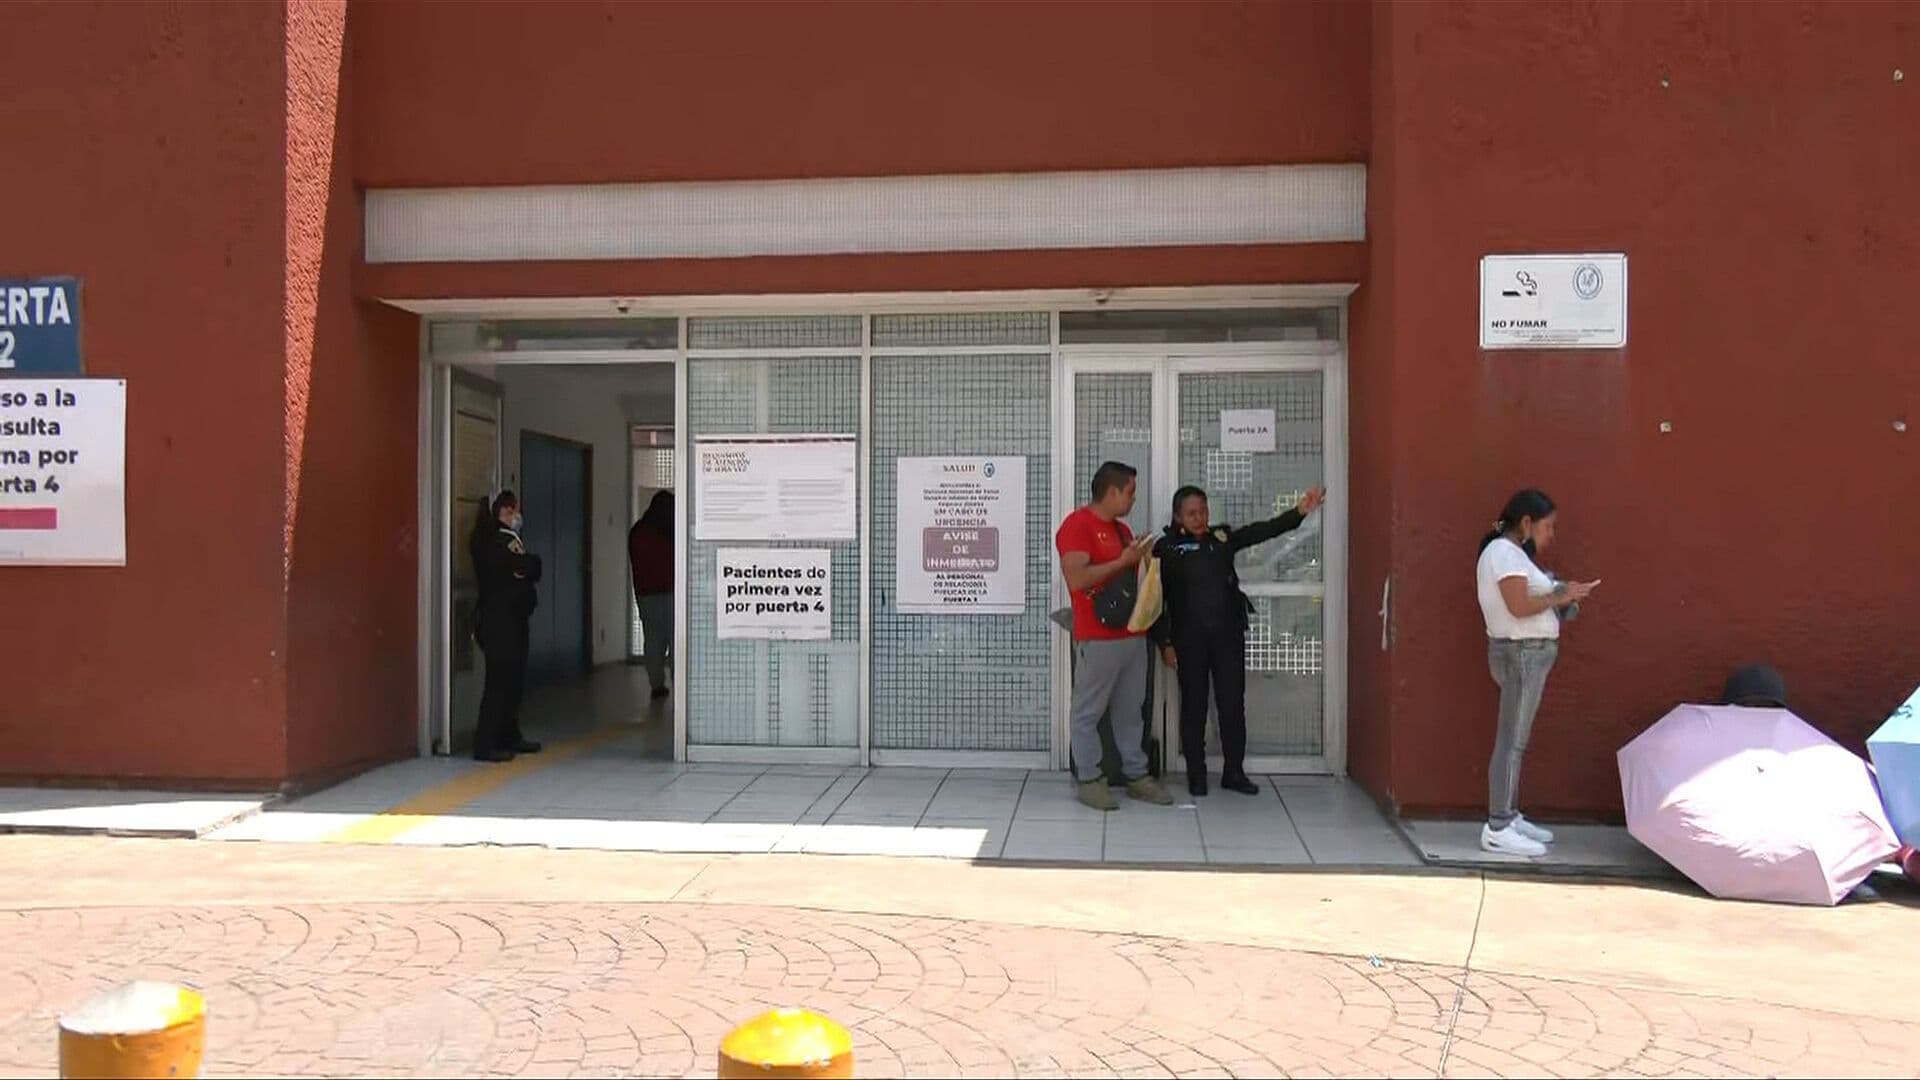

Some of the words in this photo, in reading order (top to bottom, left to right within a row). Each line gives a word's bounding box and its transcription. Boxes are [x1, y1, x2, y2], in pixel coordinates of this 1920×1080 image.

[1491, 320, 1507, 328] NO
[1509, 320, 1548, 328] FUMAR
[0, 331, 16, 368] 2
[34, 392, 48, 407] a
[55, 388, 76, 407] la
[0, 417, 61, 436] sulta
[38, 449, 79, 469] por
[943, 464, 976, 472] SALUD
[44, 475, 60, 493] 4
[943, 531, 979, 541] AVISE
[952, 545, 969, 554] DE
[926, 557, 996, 569] INMEDIATO
[723, 564, 802, 578] Pacientes
[806, 566, 826, 578] de
[727, 581, 790, 598] primera
[794, 585, 823, 596] vez
[725, 602, 751, 615] por
[755, 601, 809, 616] puerta
[813, 601, 825, 613] 4
